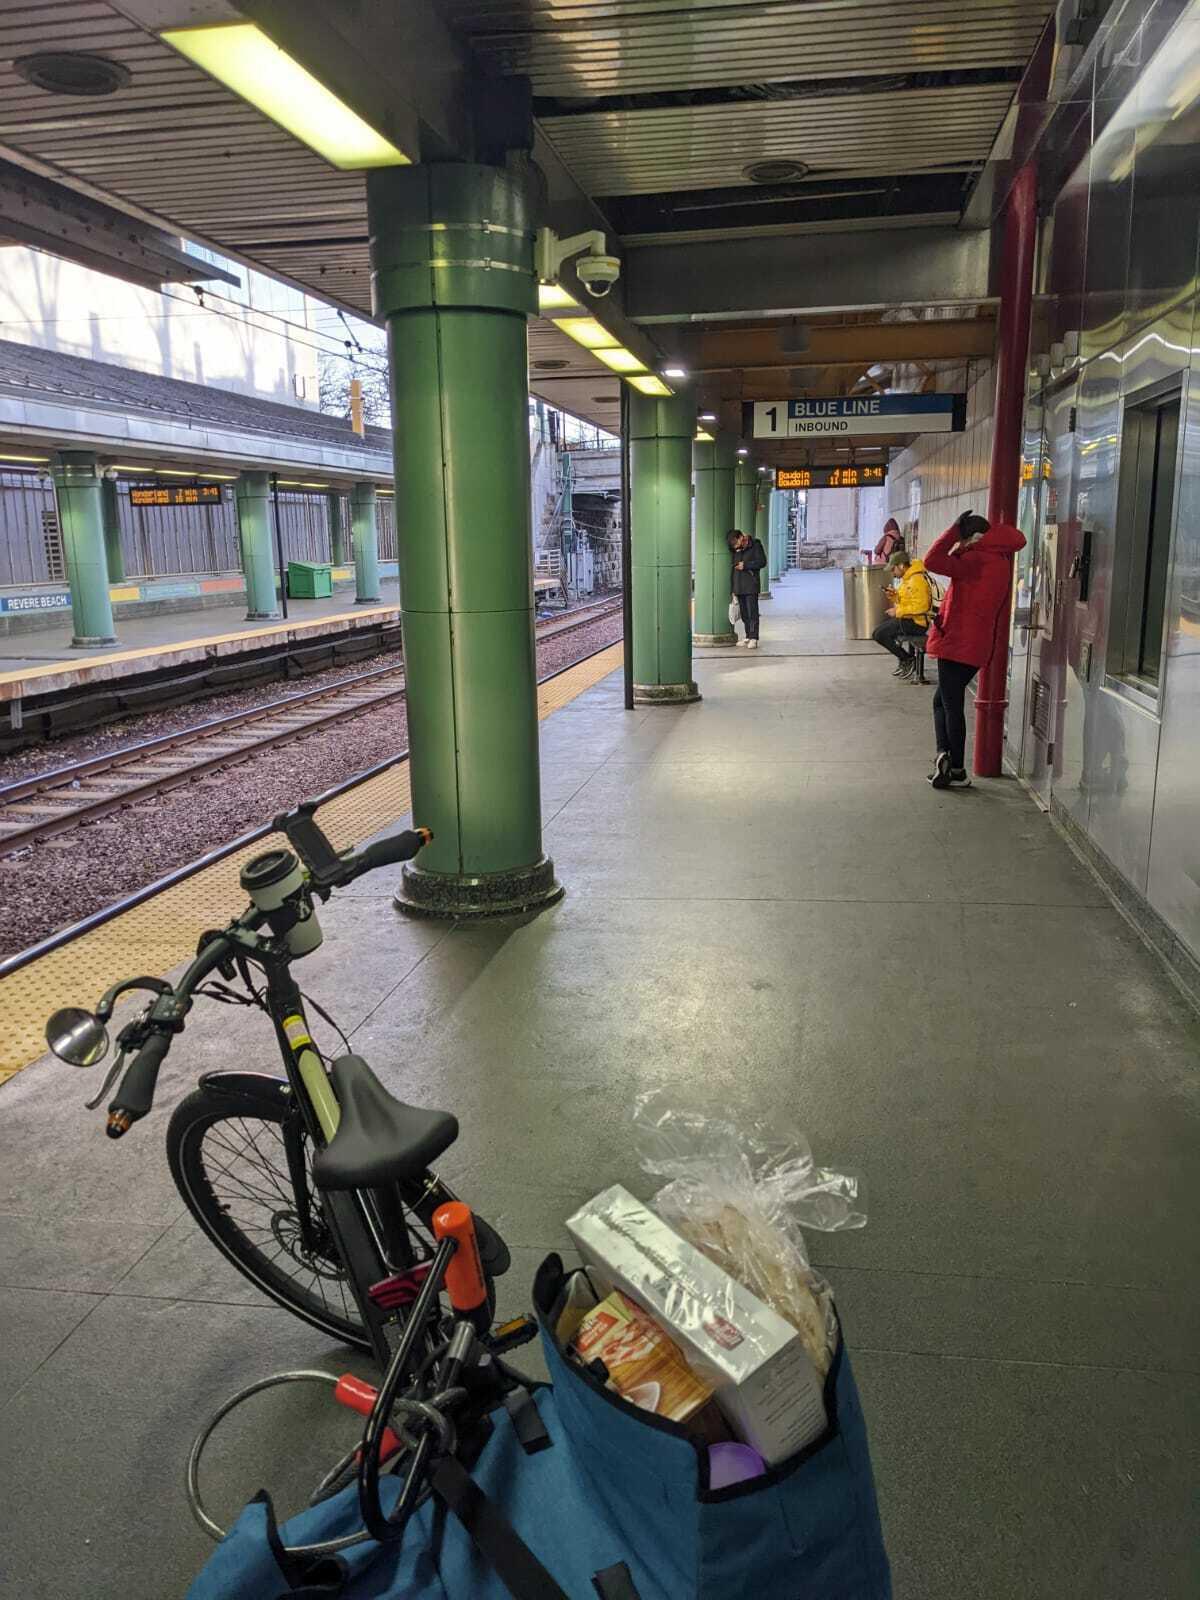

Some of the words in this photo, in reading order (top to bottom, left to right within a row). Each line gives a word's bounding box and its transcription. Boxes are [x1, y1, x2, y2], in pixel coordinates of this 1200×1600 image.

[794, 401, 837, 417] BLUE
[843, 400, 880, 415] LINE
[765, 406, 777, 432] 1
[794, 421, 848, 433] INBOUND
[8, 597, 40, 609] REVERE
[40, 594, 67, 608] BEACH
